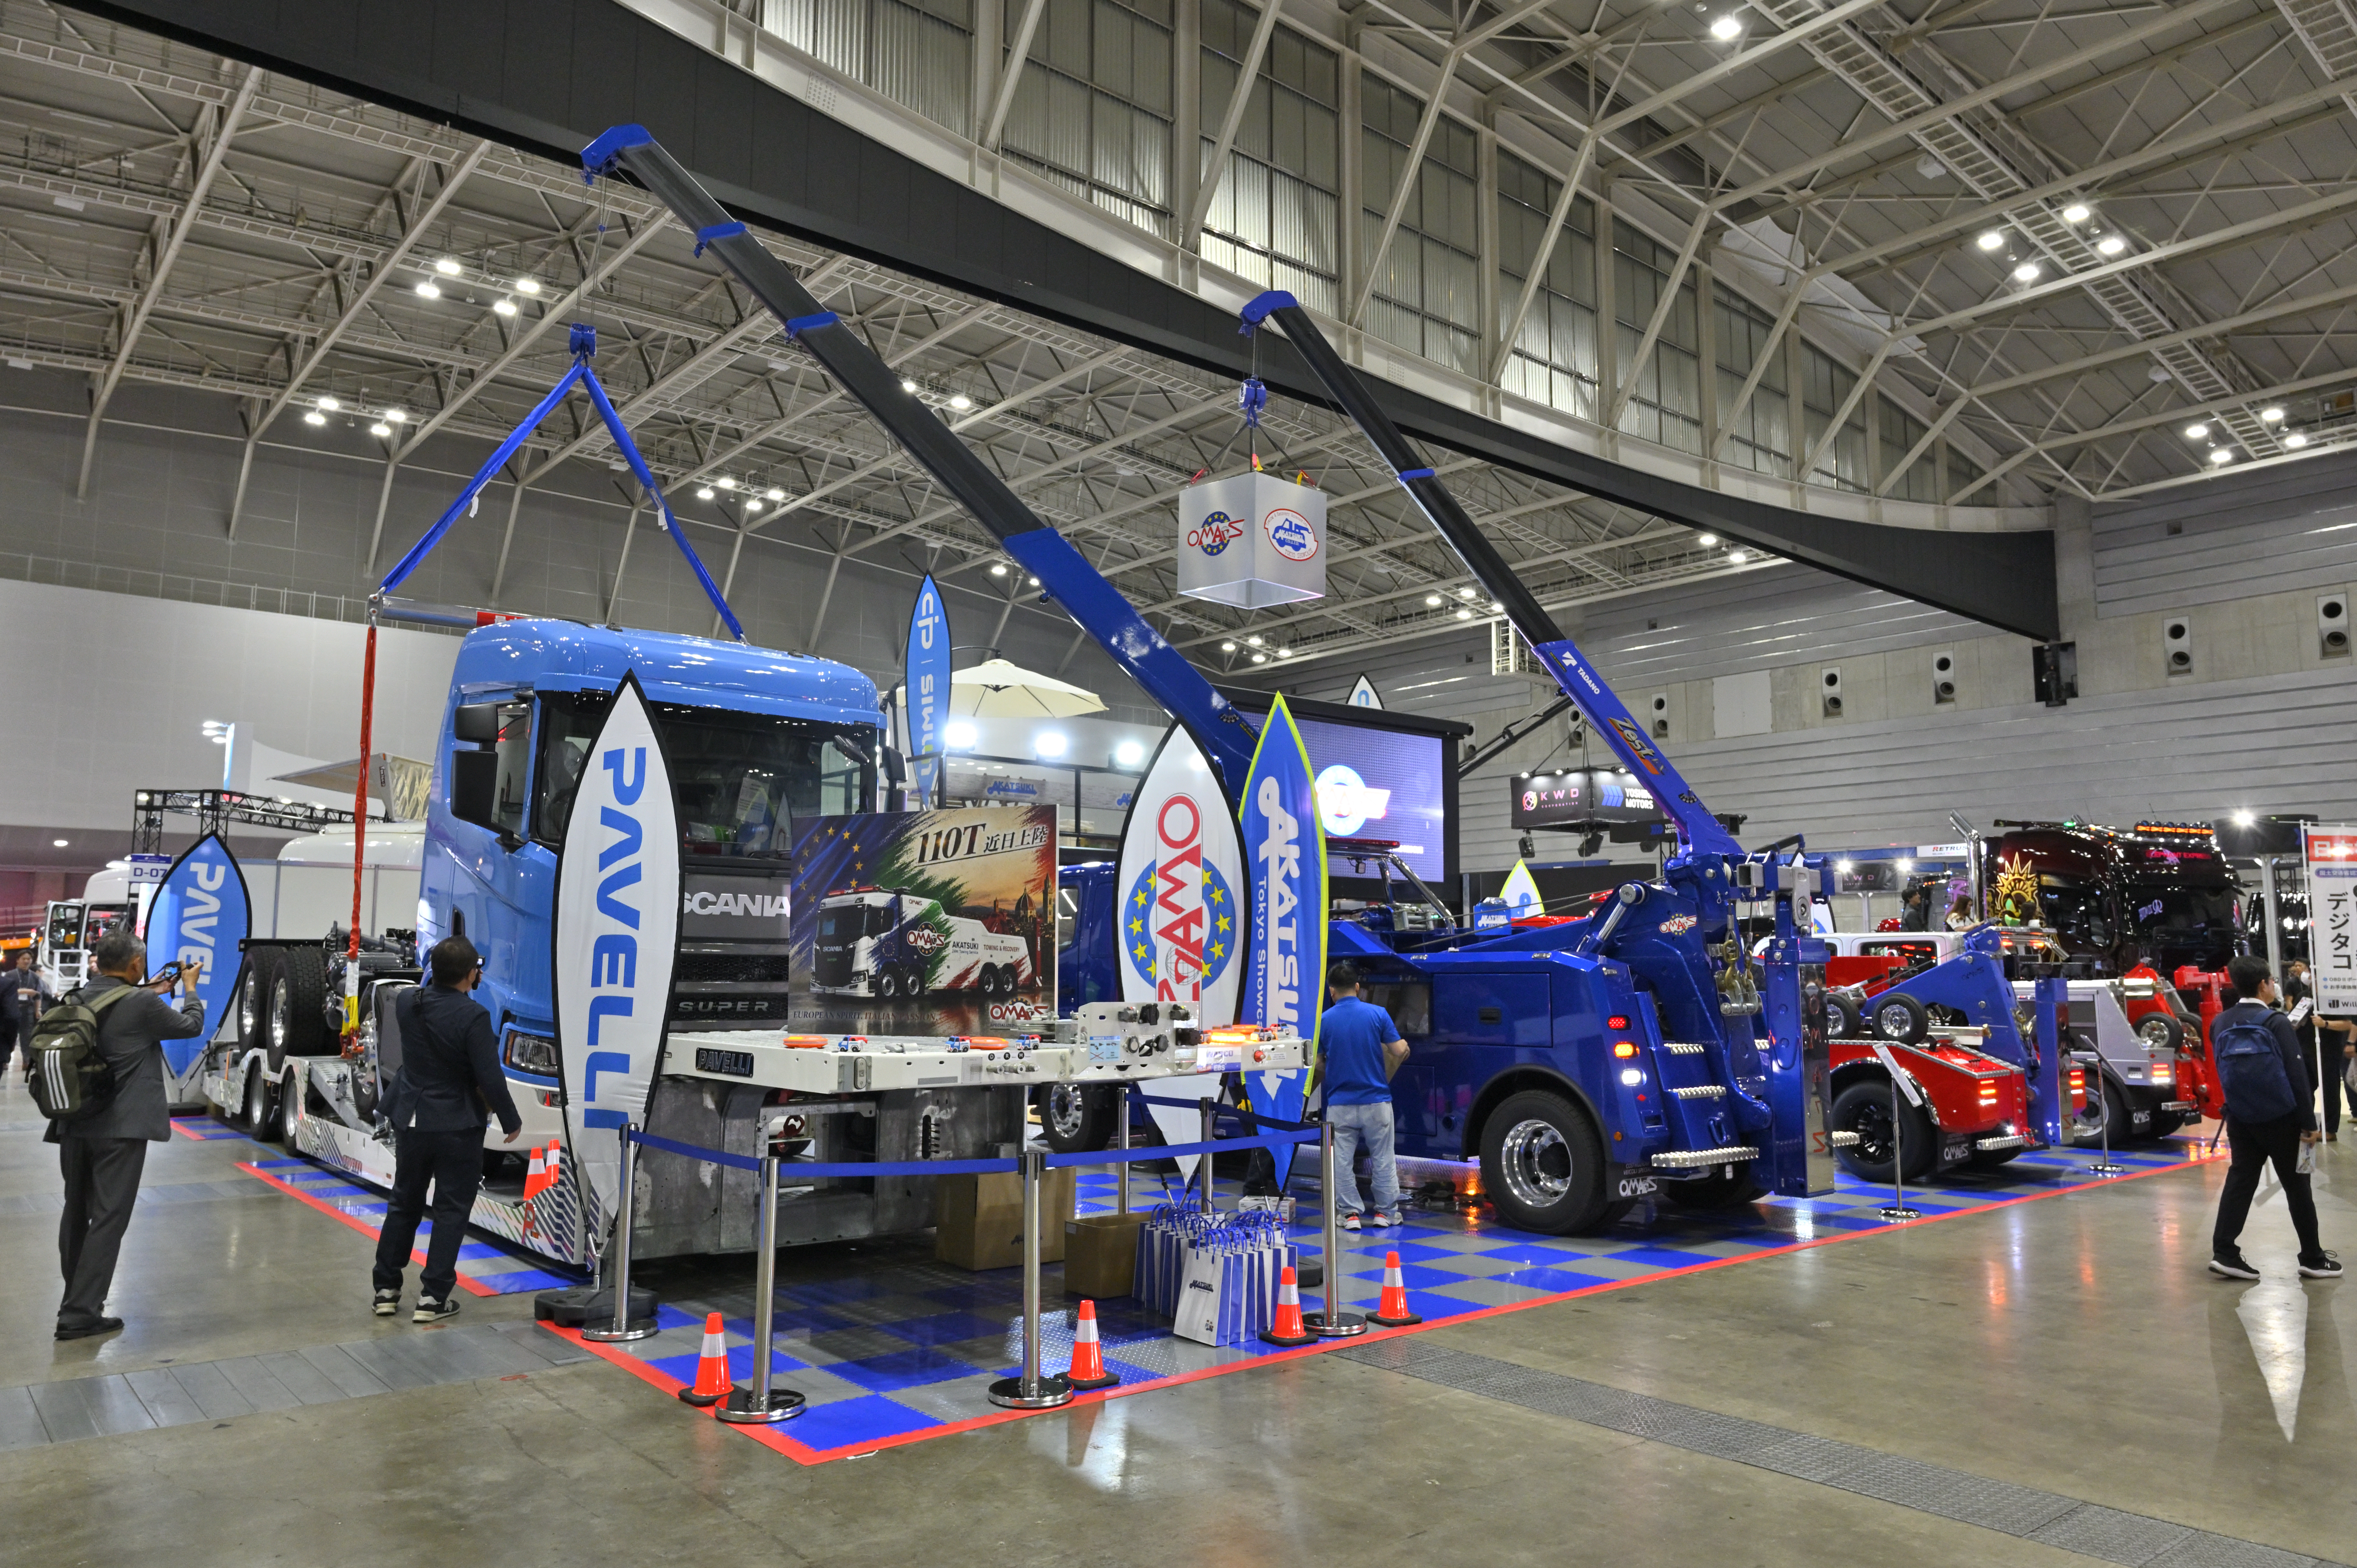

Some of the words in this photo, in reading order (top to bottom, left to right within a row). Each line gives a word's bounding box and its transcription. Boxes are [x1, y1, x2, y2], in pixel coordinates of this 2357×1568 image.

[1275, 529, 1305, 544] AKATSUKI
[1577, 666, 1600, 695] TADANO
[1609, 717, 1655, 760] Zest
[987, 780, 1037, 795] AKATSUKI
[1626, 798, 1654, 810] MOTORS
[917, 823, 987, 864] 110T
[984, 826, 1048, 853] 近日上陸
[1257, 876, 1266, 940] Tokyo
[1478, 915, 1508, 927] AKATSUKI
[2327, 892, 2351, 969] デジタコ
[584, 747, 646, 1130] PAVELLI
[952, 941, 979, 950] AKATSUKI
[1257, 949, 1267, 1028] Showca
[678, 1001, 769, 1012] SUPER
[793, 1011, 835, 1019] EUROPEAN
[864, 1011, 896, 1020] ITALIAN
[698, 1051, 751, 1075] PAVELLI
[1189, 1279, 1214, 1293] AKATSUKI
